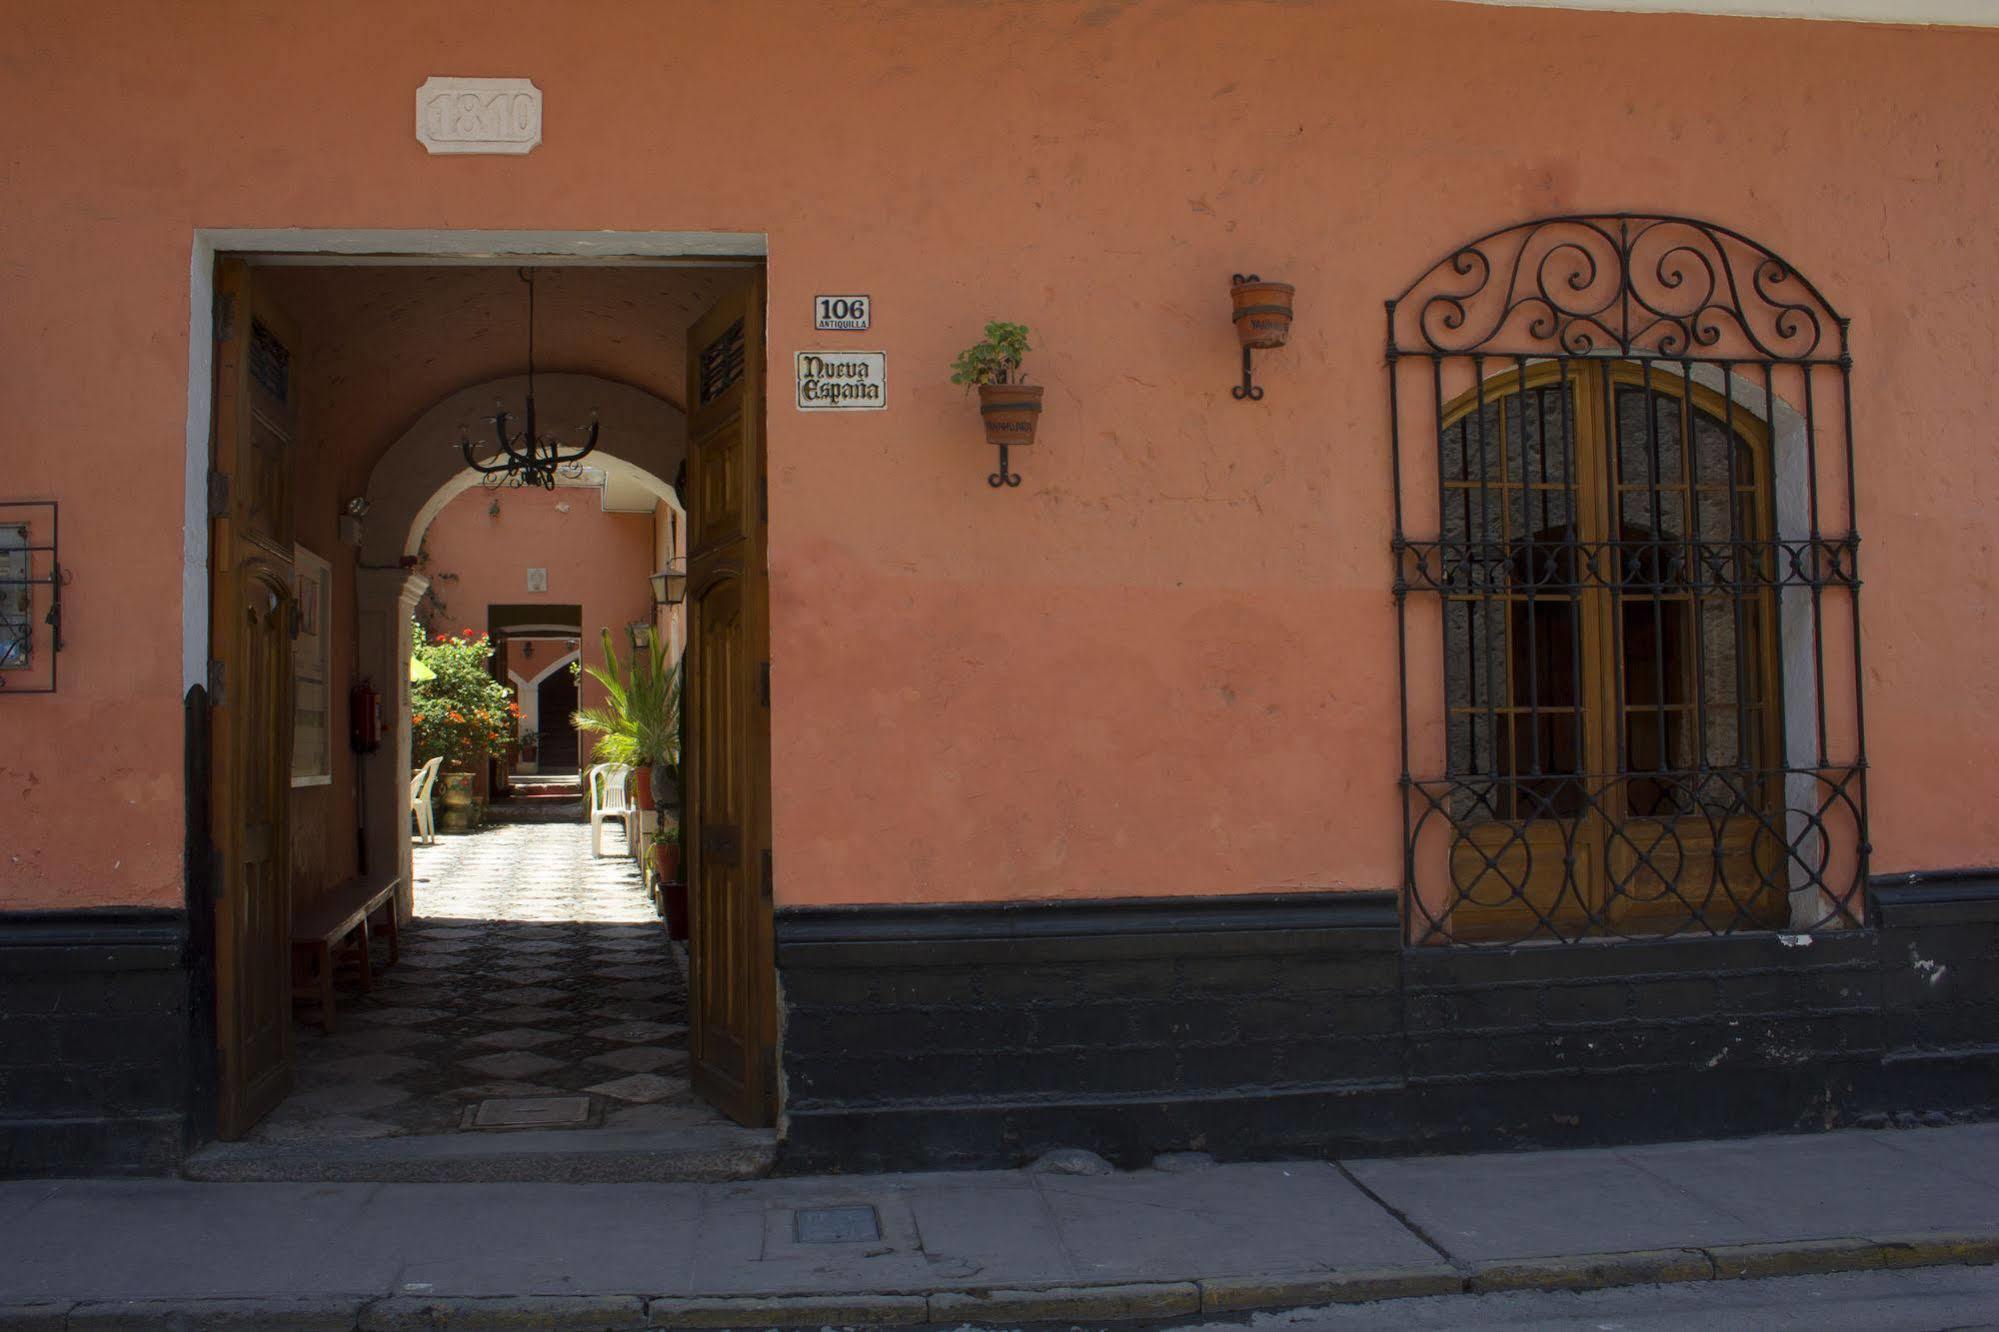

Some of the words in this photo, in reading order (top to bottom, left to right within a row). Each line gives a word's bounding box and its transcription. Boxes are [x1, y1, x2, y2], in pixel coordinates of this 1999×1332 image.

[427, 93, 533, 138] 1810
[820, 299, 865, 320] 106
[818, 320, 867, 328] ANTIQUILLA
[803, 356, 869, 379] Nueva
[802, 379, 879, 404] España
